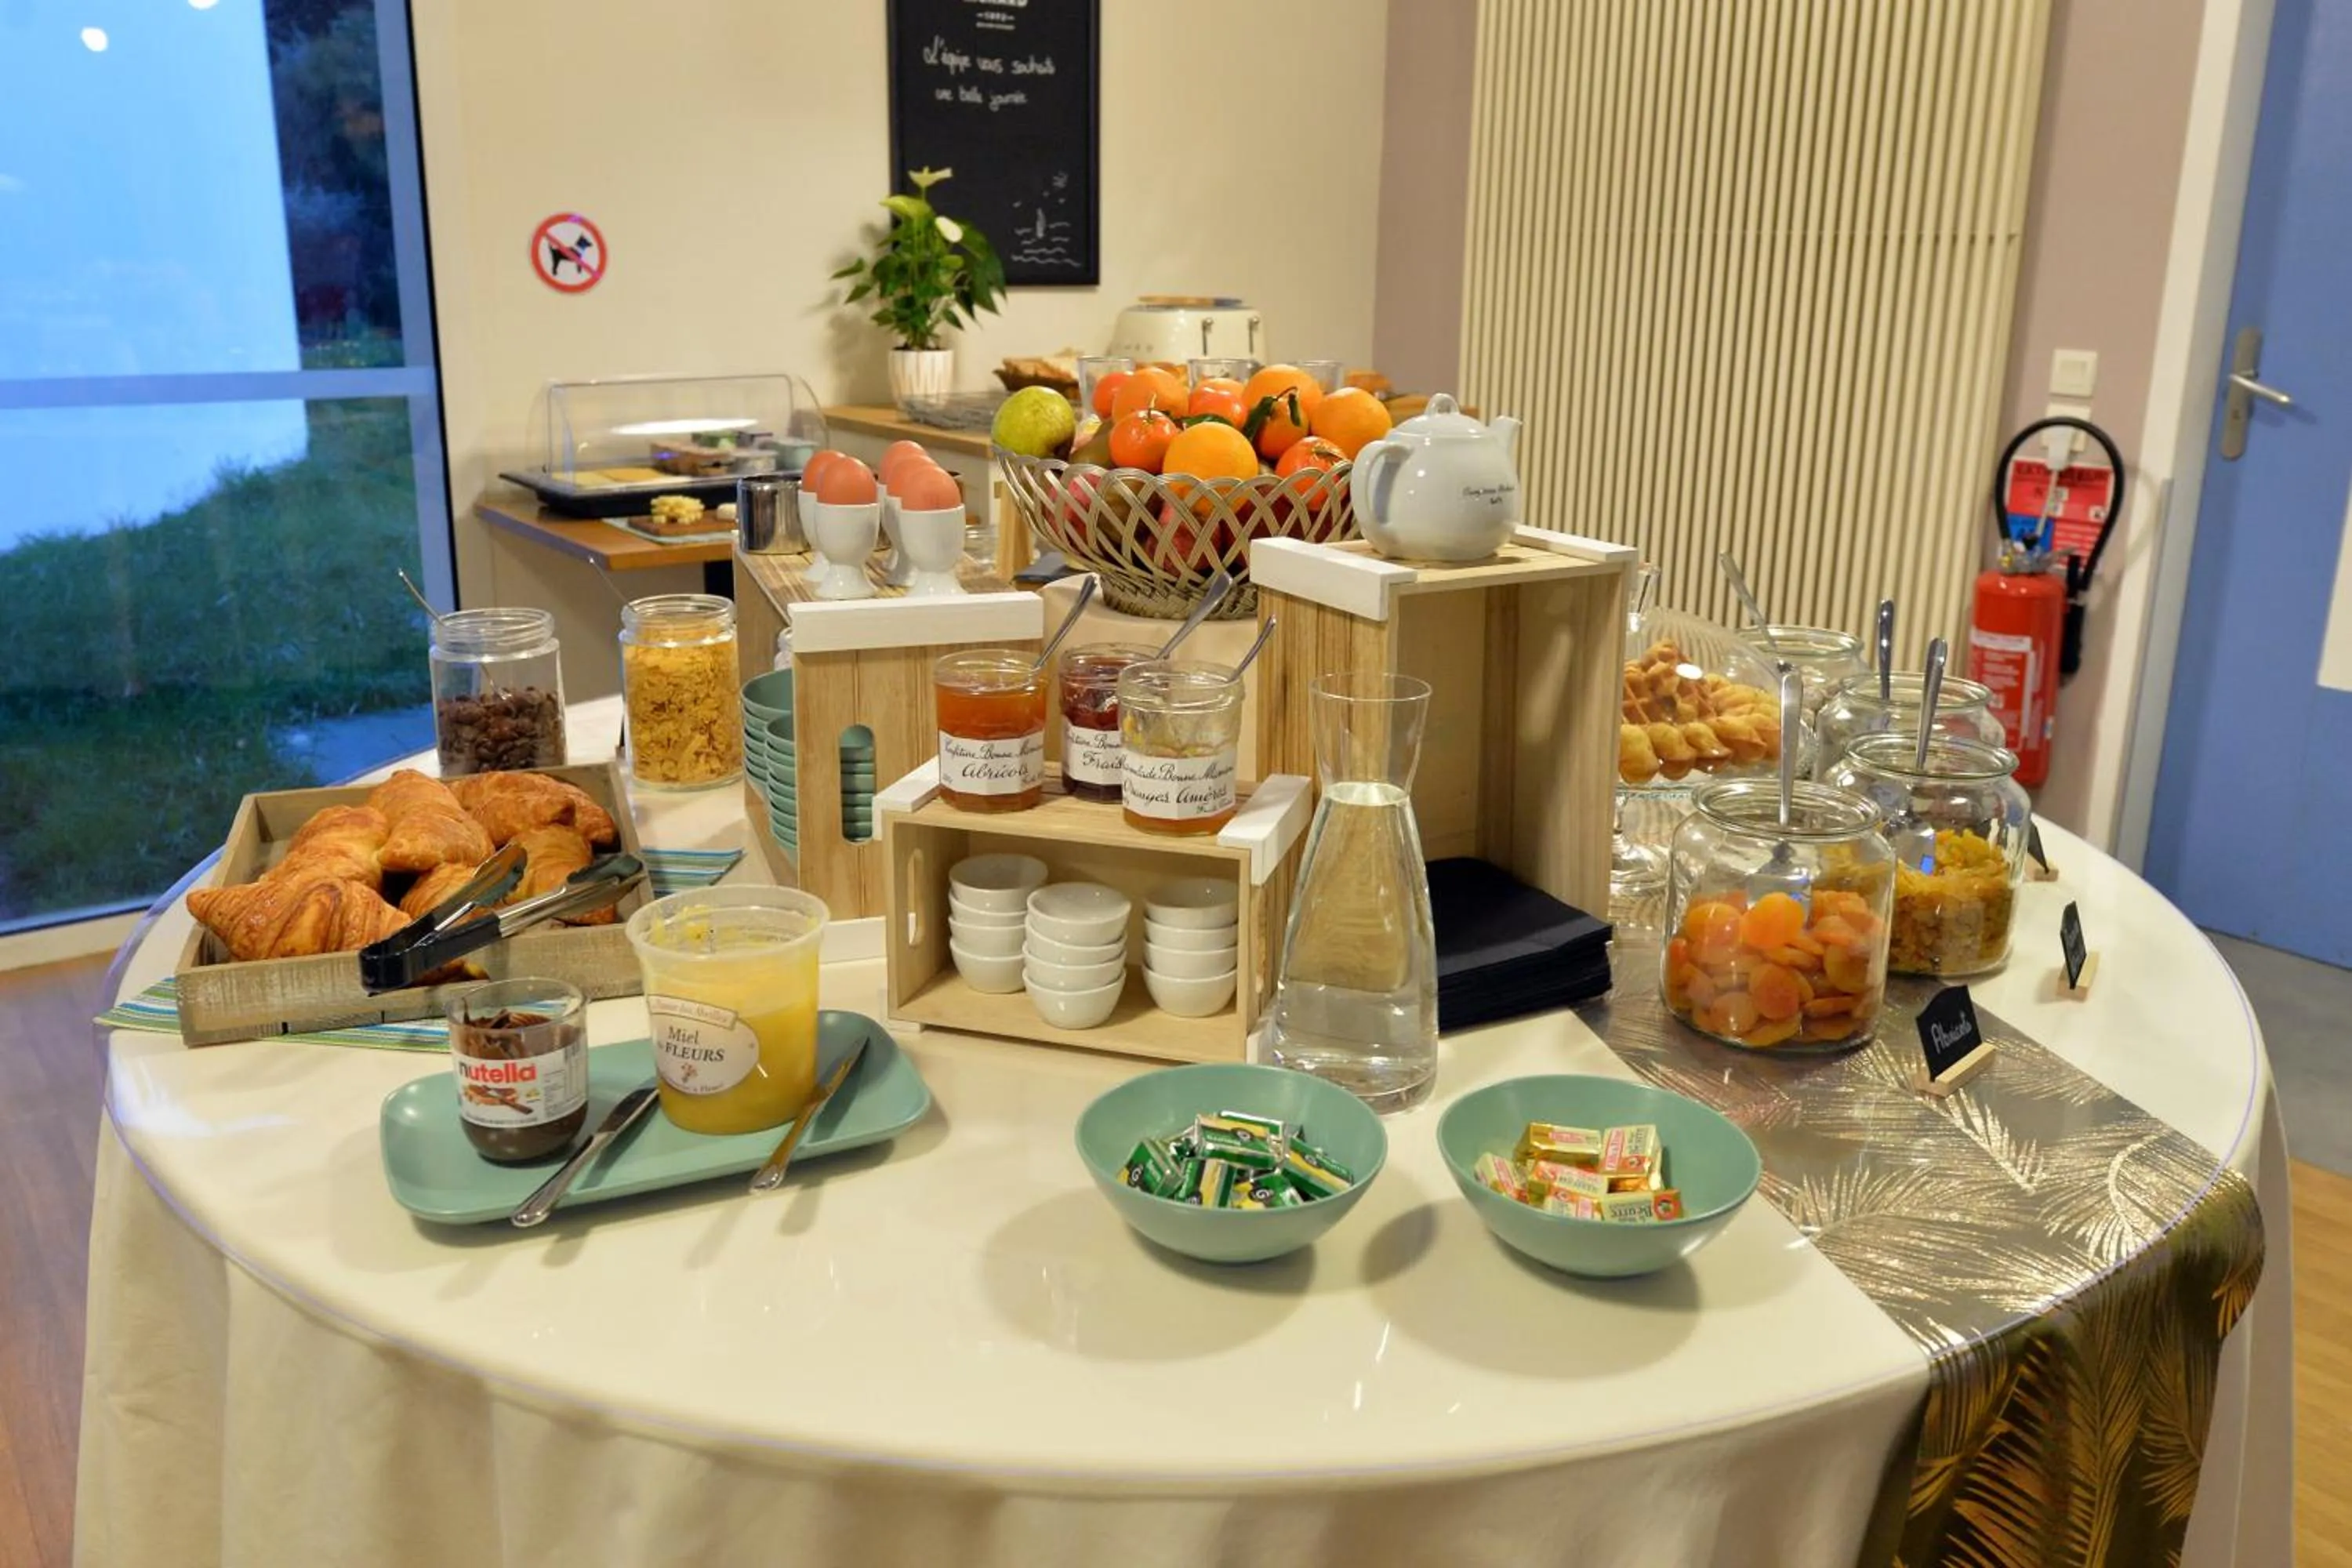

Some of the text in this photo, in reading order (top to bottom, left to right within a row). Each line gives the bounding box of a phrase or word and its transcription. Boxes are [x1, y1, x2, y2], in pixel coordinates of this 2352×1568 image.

[669, 1025, 699, 1044] Miel
[665, 1042, 725, 1062] FLEURS
[459, 1062, 536, 1083] nutella
